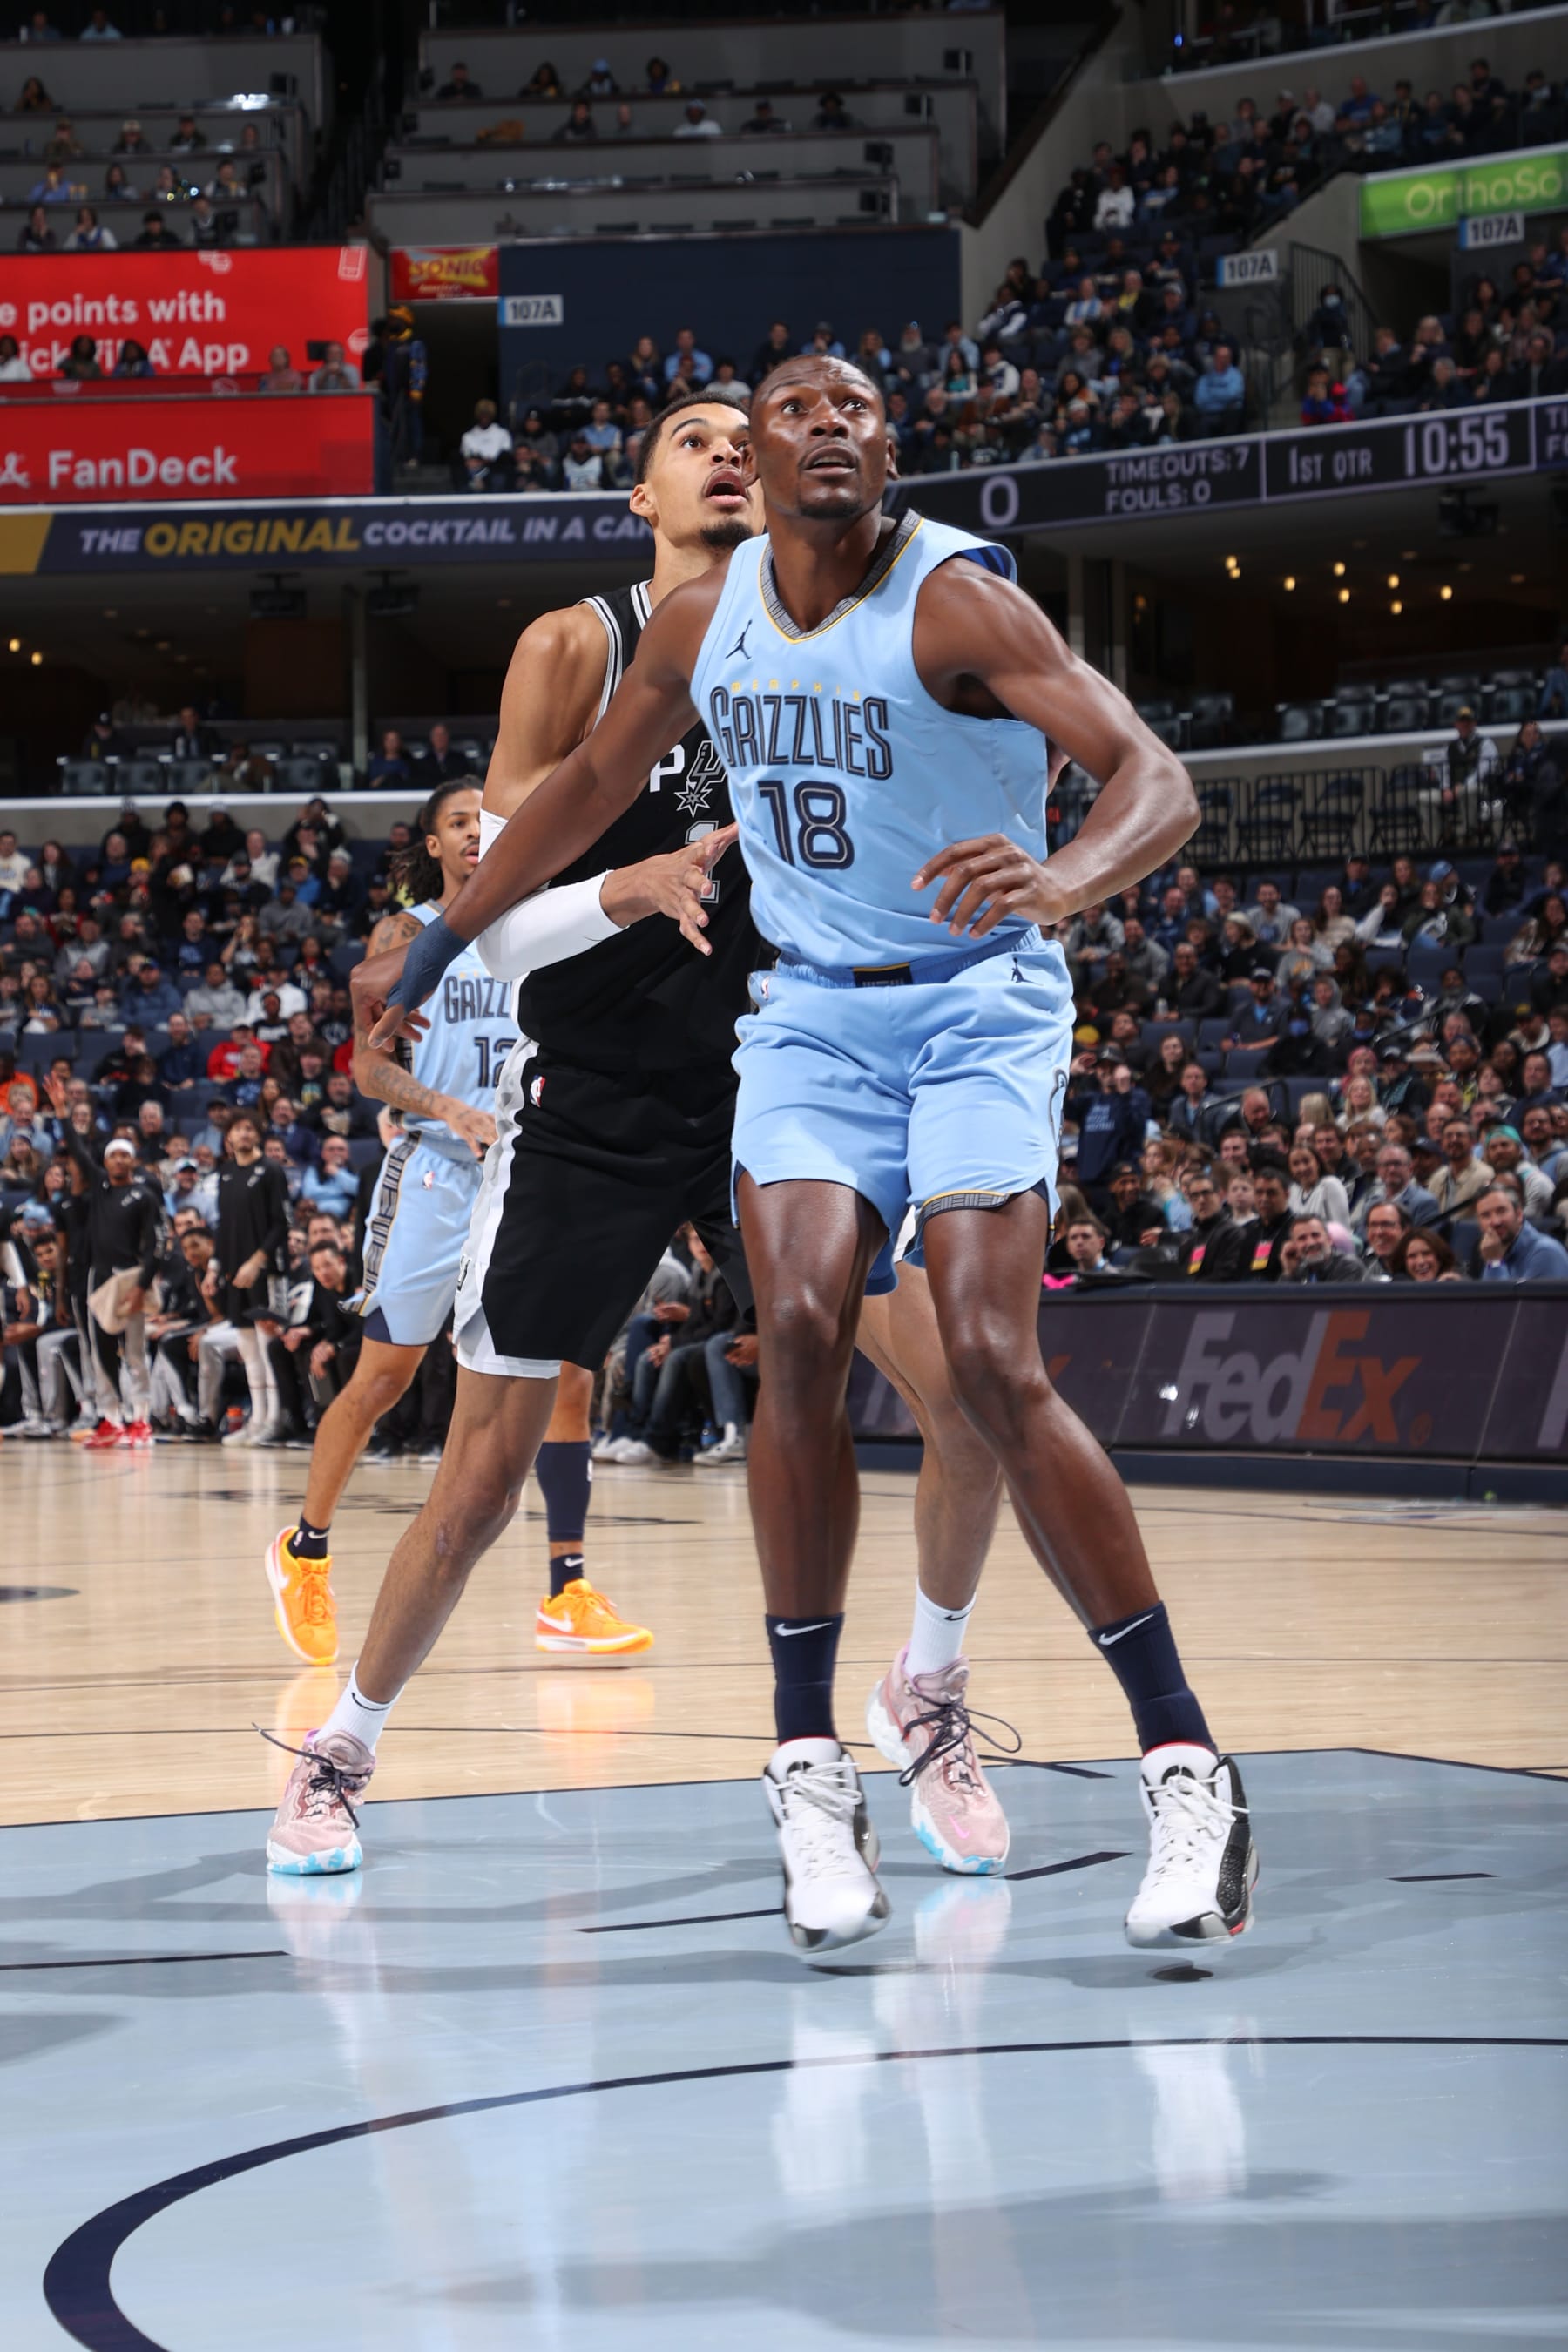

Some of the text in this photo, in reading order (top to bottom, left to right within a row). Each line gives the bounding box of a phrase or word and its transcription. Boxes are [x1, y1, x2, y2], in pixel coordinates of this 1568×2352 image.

[1405, 166, 1564, 218] OrthoSo
[1470, 216, 1520, 242] 107A
[1228, 253, 1273, 280] 107A
[28, 293, 139, 334] points
[147, 289, 226, 323] with
[510, 300, 557, 321] 107A
[179, 336, 250, 376] App
[0, 445, 238, 489] & FanDeck
[1405, 412, 1509, 477] 10:55
[980, 474, 1020, 528] 0
[1105, 478, 1212, 514] FOULS: 0
[79, 528, 141, 556] THE
[144, 517, 361, 558] ORIGINAL
[363, 517, 516, 546] COCKTAIL
[523, 517, 558, 543] IN
[562, 515, 585, 541] A
[709, 685, 894, 781] GRIZZLIES
[756, 779, 855, 870] 18
[443, 975, 513, 1024] GRIZZ
[1159, 1309, 1423, 1443] FedEx
